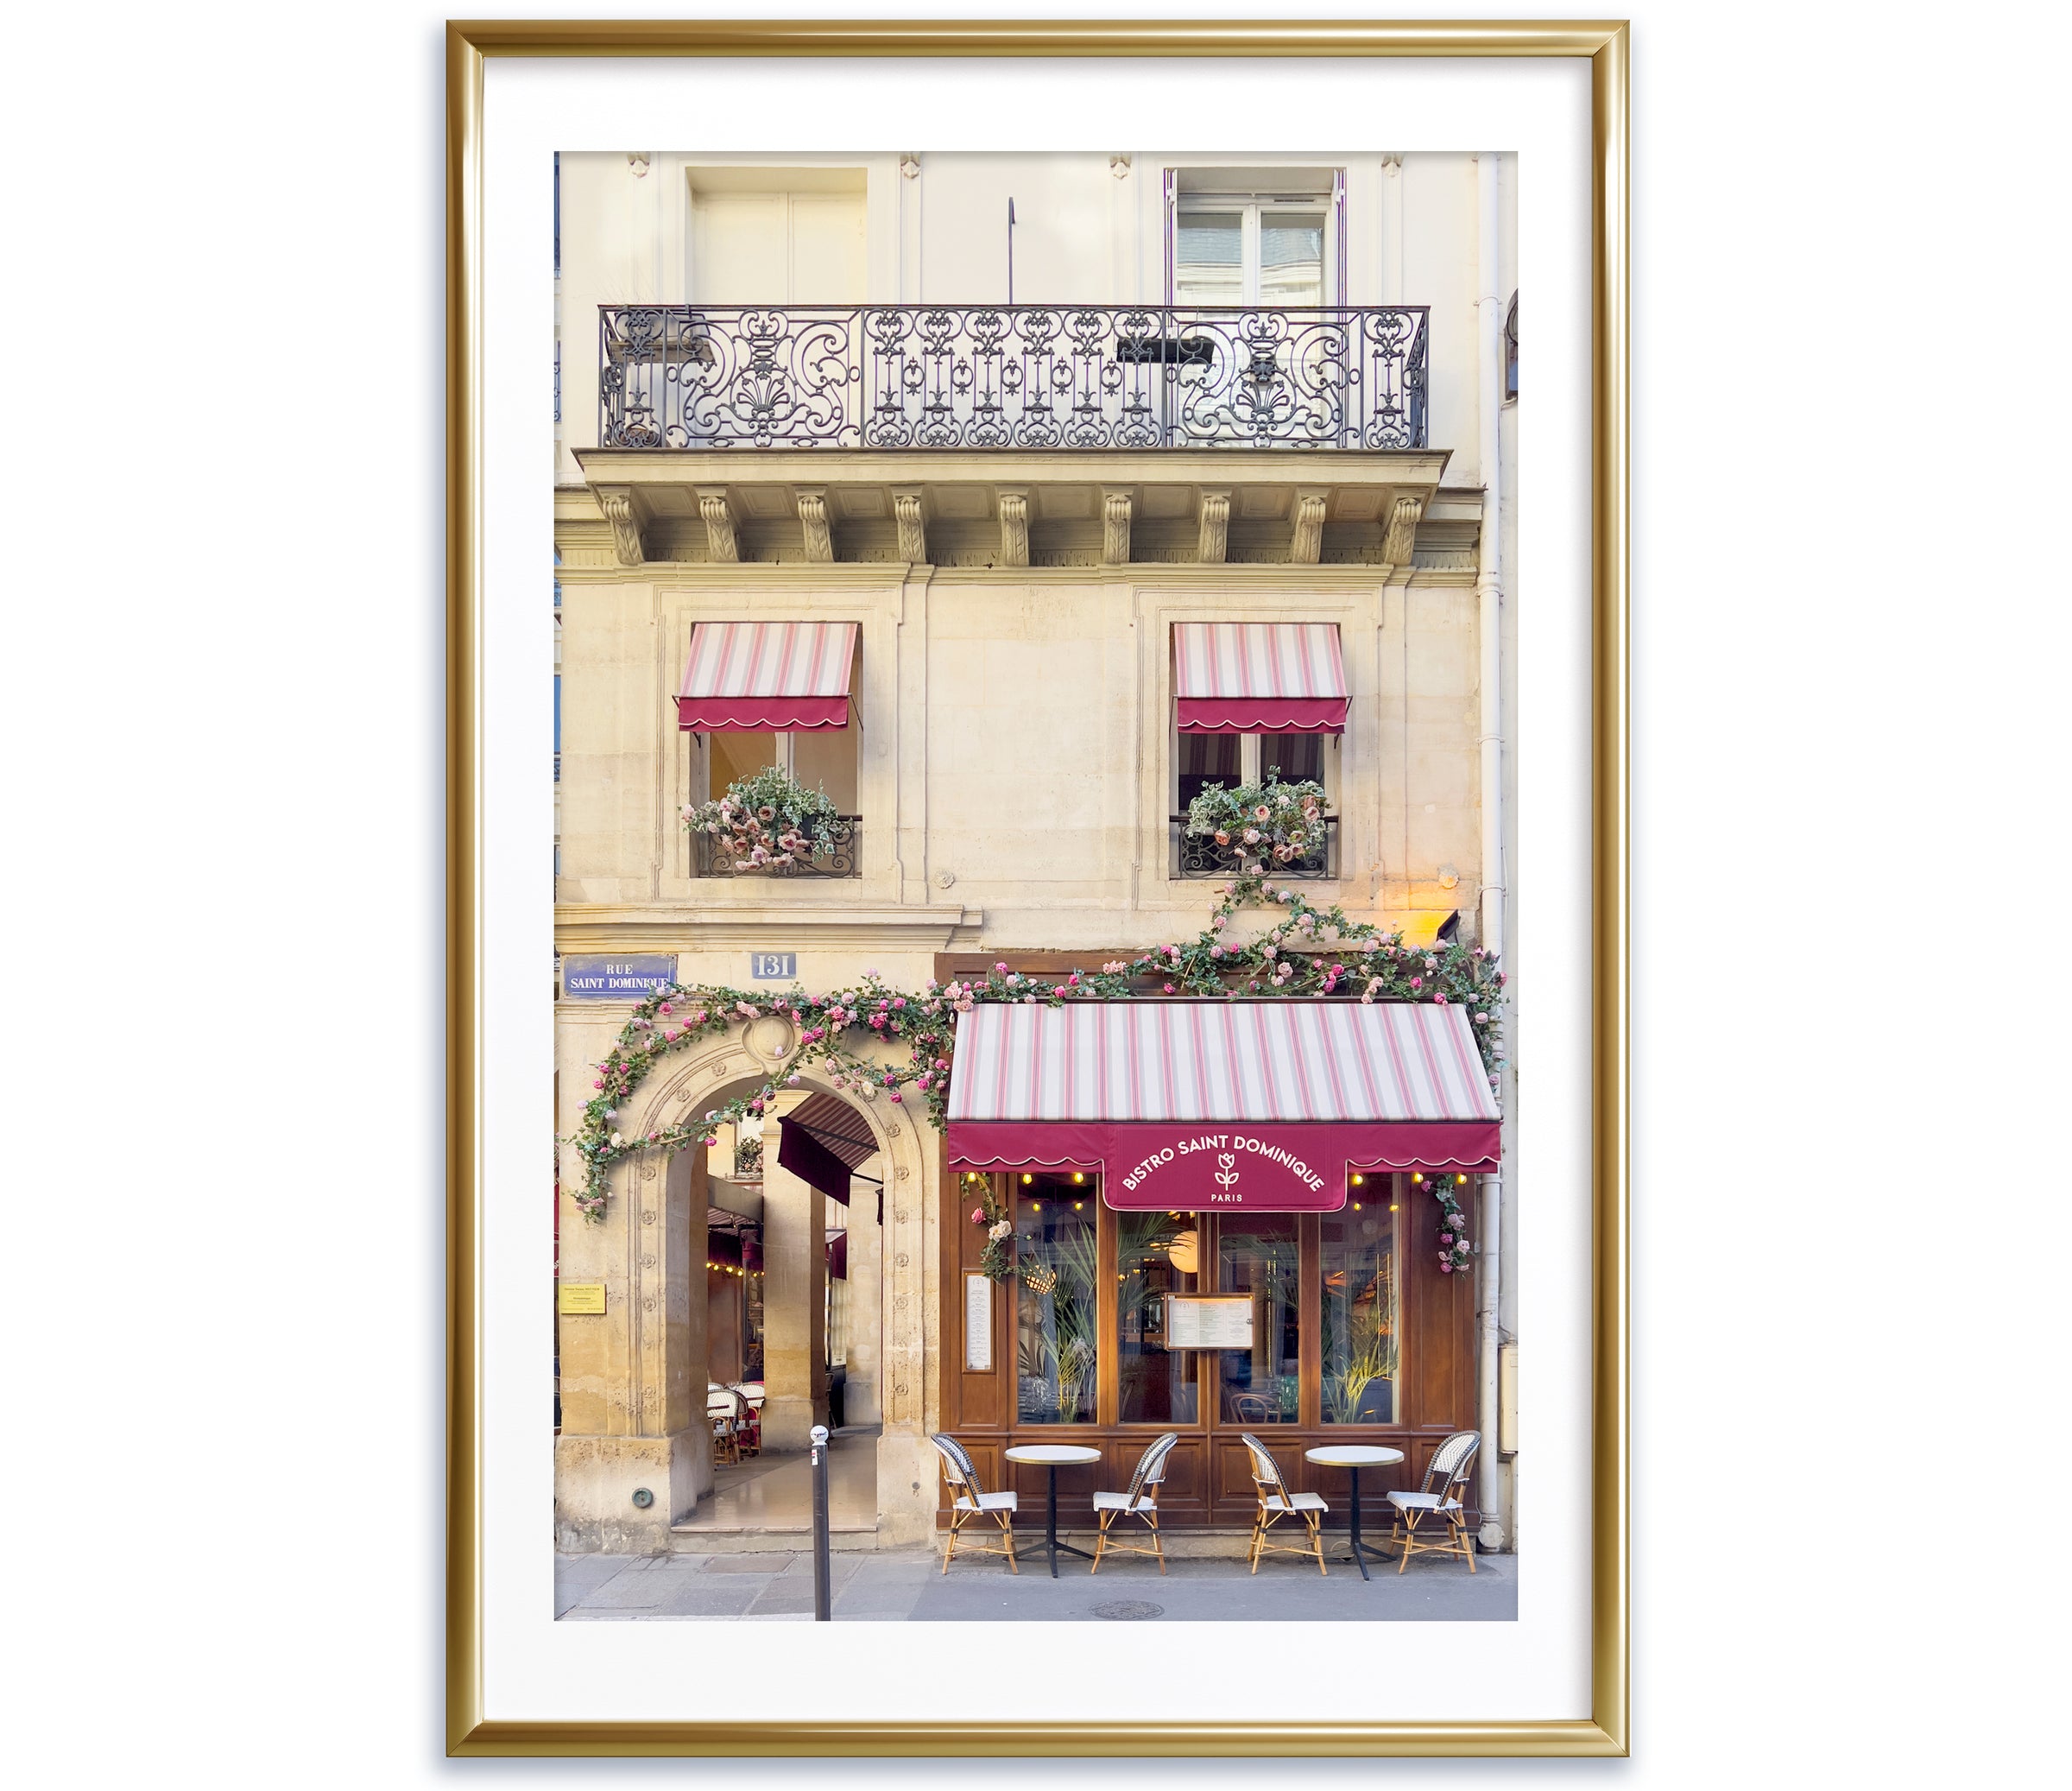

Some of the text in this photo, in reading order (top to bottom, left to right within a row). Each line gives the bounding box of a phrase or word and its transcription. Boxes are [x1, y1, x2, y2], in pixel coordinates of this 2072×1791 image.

[606, 964, 633, 974] RUE
[757, 955, 789, 976] 131
[571, 978, 669, 990] SAINT DOMINIQUE
[1122, 1135, 1325, 1193] BISTRO SAINT DOMINIQUE
[1210, 1193, 1243, 1202] PARIS
